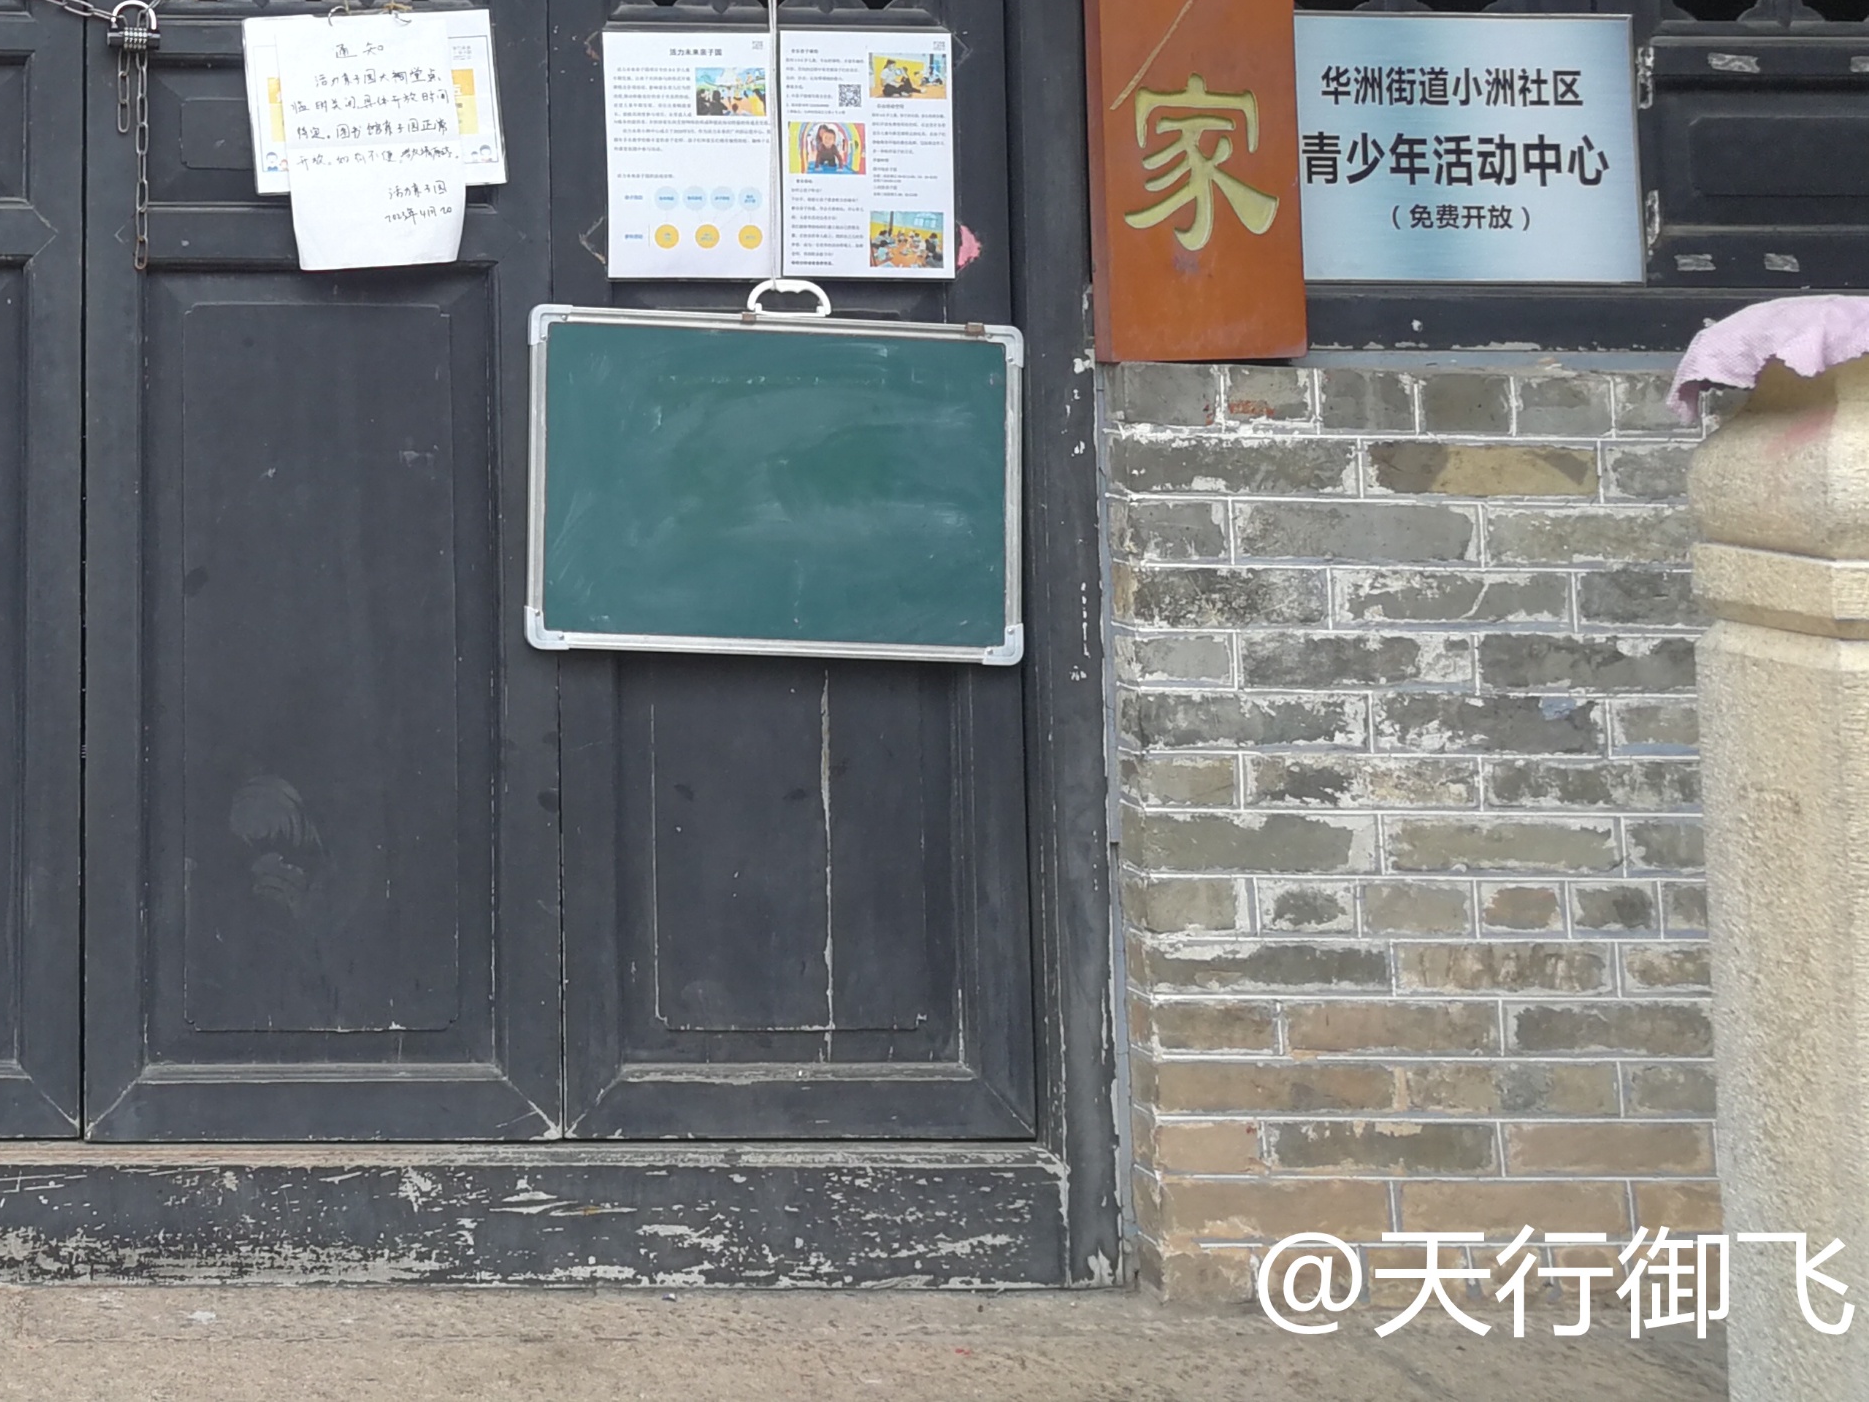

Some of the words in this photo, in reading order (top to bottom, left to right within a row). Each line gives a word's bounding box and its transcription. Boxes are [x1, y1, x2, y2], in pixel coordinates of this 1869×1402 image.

[335, 42, 385, 59] 通知
[1321, 66, 1584, 107] 华洲街道小洲社区
[1302, 132, 1610, 187] 青少年活动中心
[1391, 204, 1530, 231] （免费开放）
